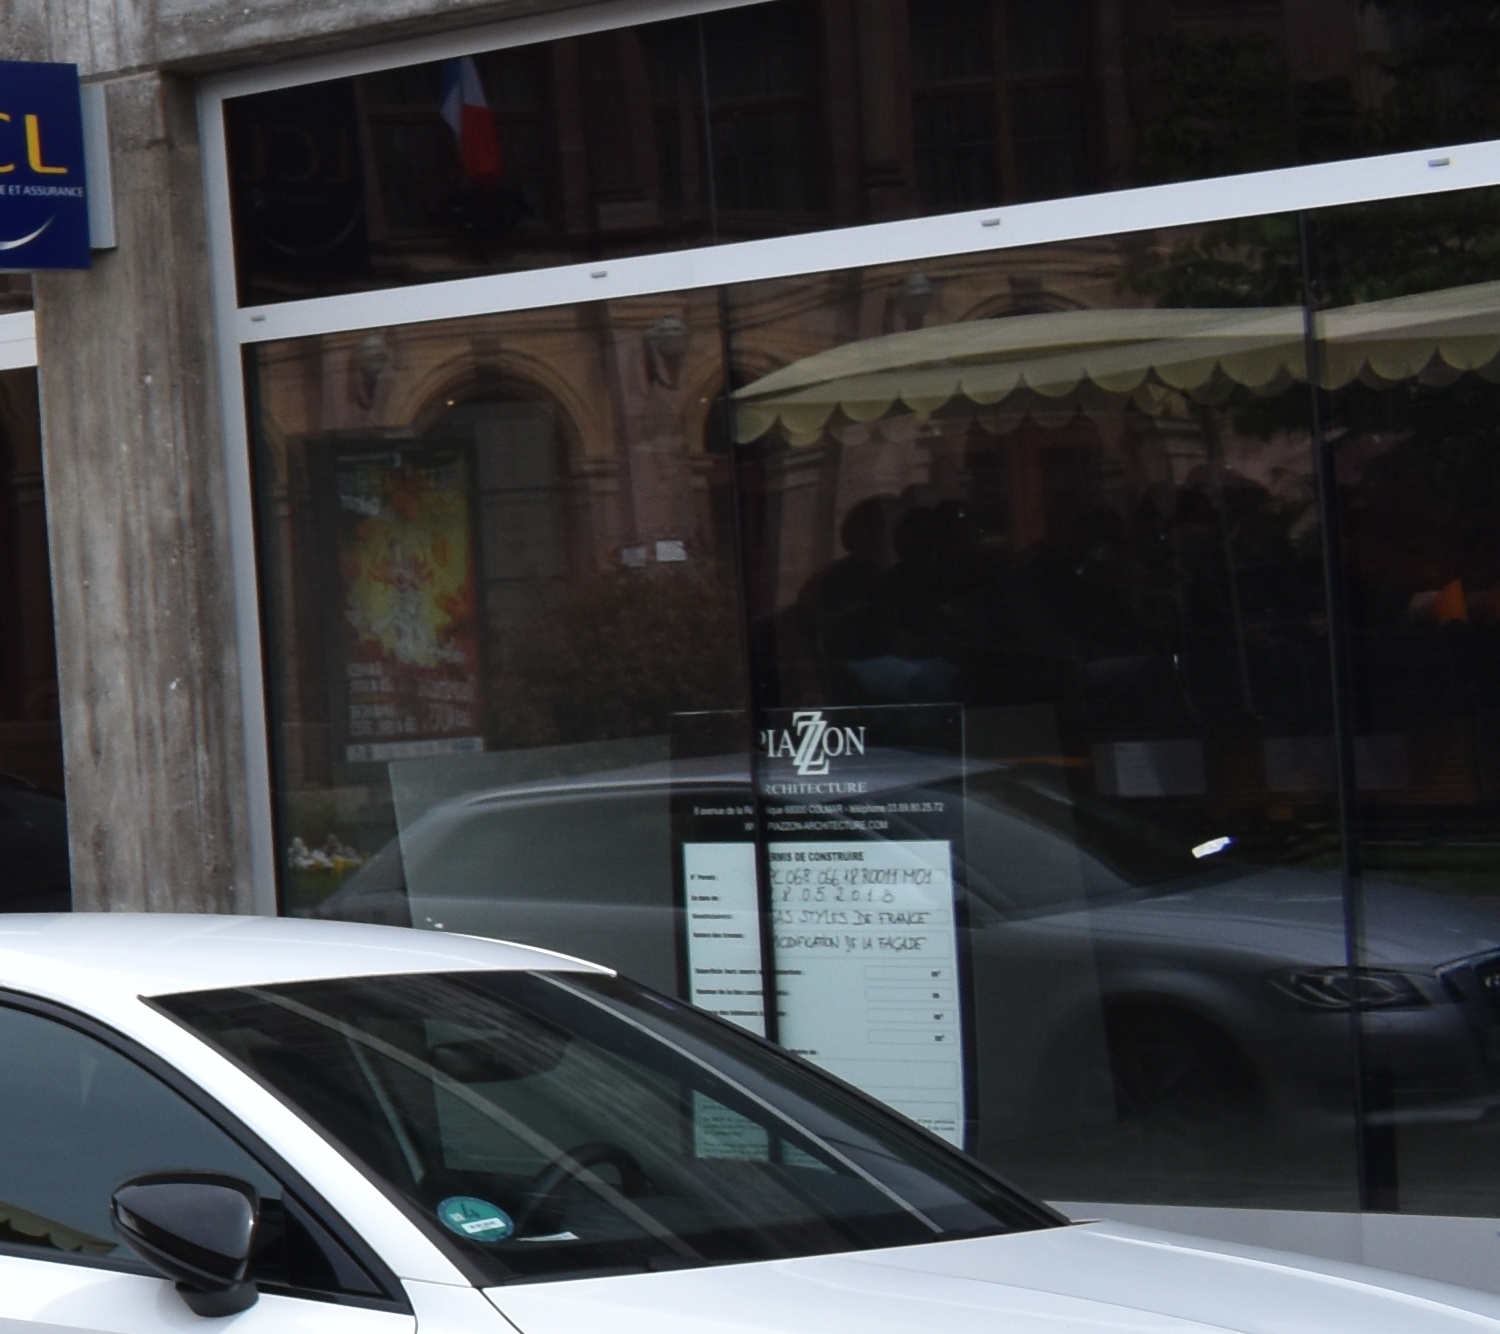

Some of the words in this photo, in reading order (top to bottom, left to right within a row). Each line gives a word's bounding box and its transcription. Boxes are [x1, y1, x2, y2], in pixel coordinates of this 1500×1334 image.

[8, 184, 21, 195] ET
[23, 185, 85, 198] ASSURANCE
[765, 782, 868, 795] RCHITECTURE
[795, 852, 806, 862] DE
[808, 852, 864, 862] CONSTRUIRE
[853, 910, 872, 925] DE
[879, 912, 930, 925] FRANCE
